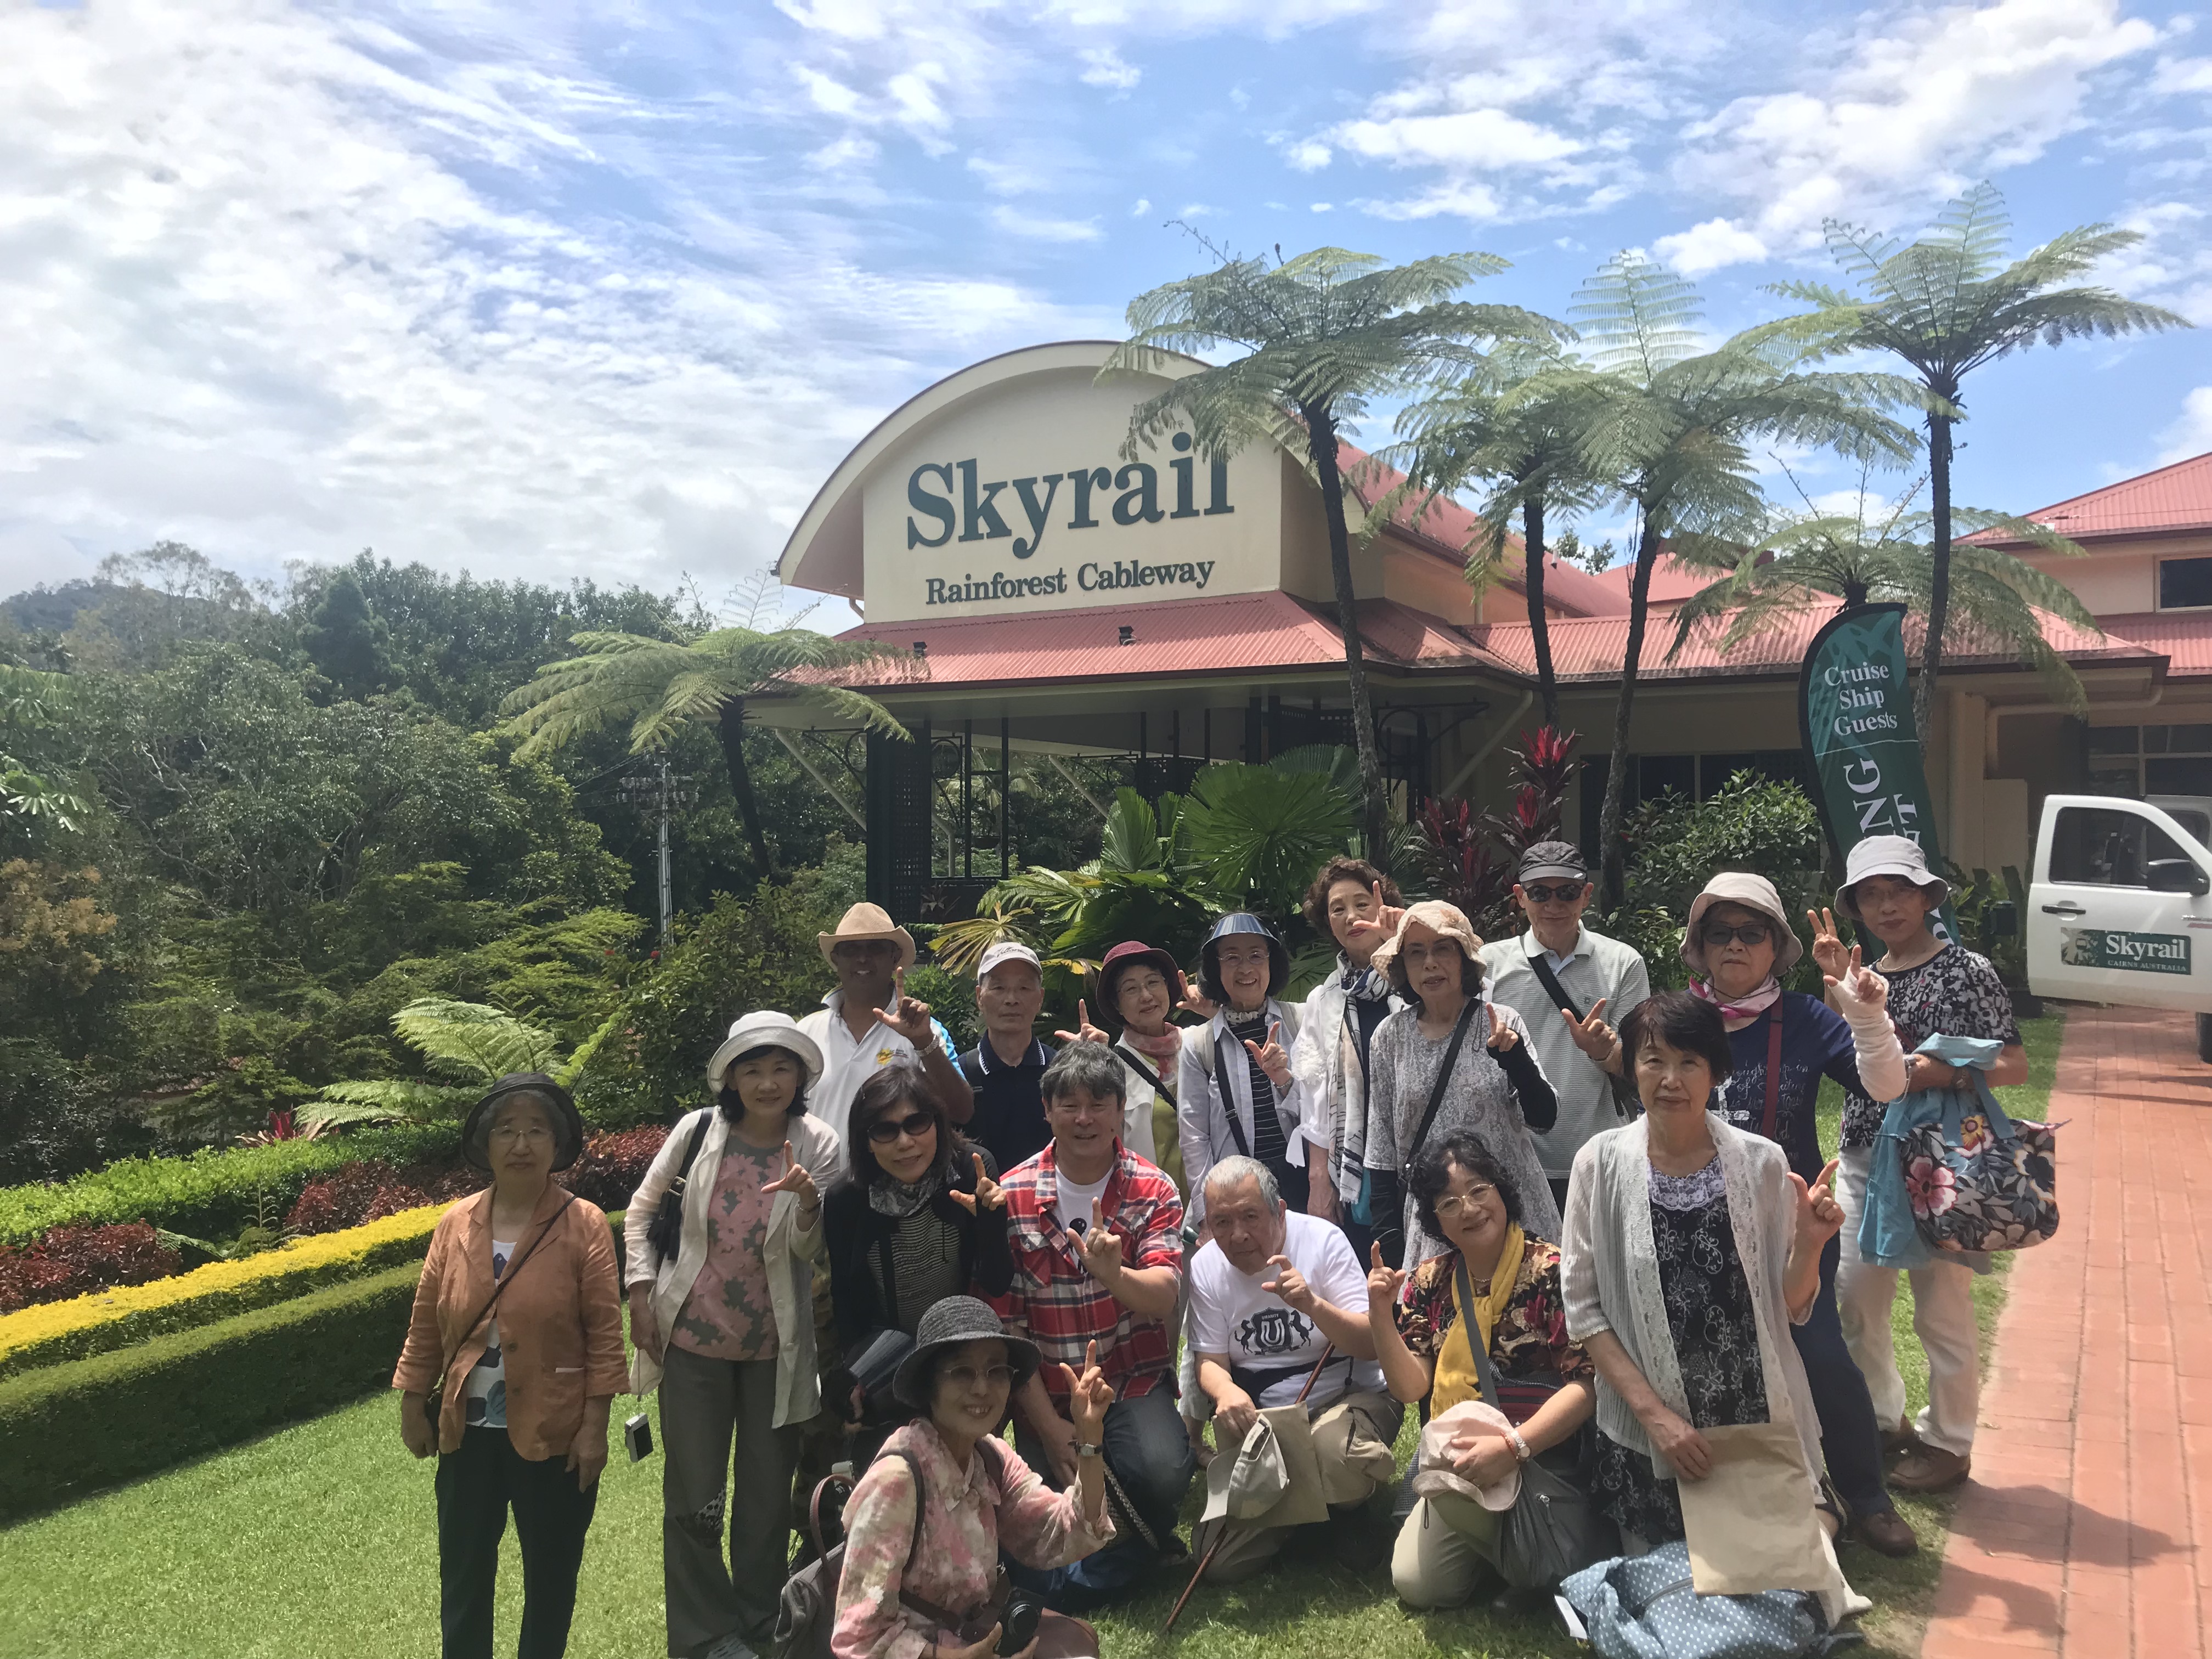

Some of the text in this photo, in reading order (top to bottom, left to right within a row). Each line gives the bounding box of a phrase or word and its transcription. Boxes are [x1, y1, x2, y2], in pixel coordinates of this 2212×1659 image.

[907, 432, 1235, 560] Skyrail
[925, 559, 1215, 605] Rainforest Cableway
[1824, 662, 1890, 686] Cruise
[1839, 686, 1884, 710] Ship
[1834, 711, 1898, 736] Guests
[2106, 934, 2187, 961] Skyrail
[2140, 962, 2187, 972] AUSTRALIA
